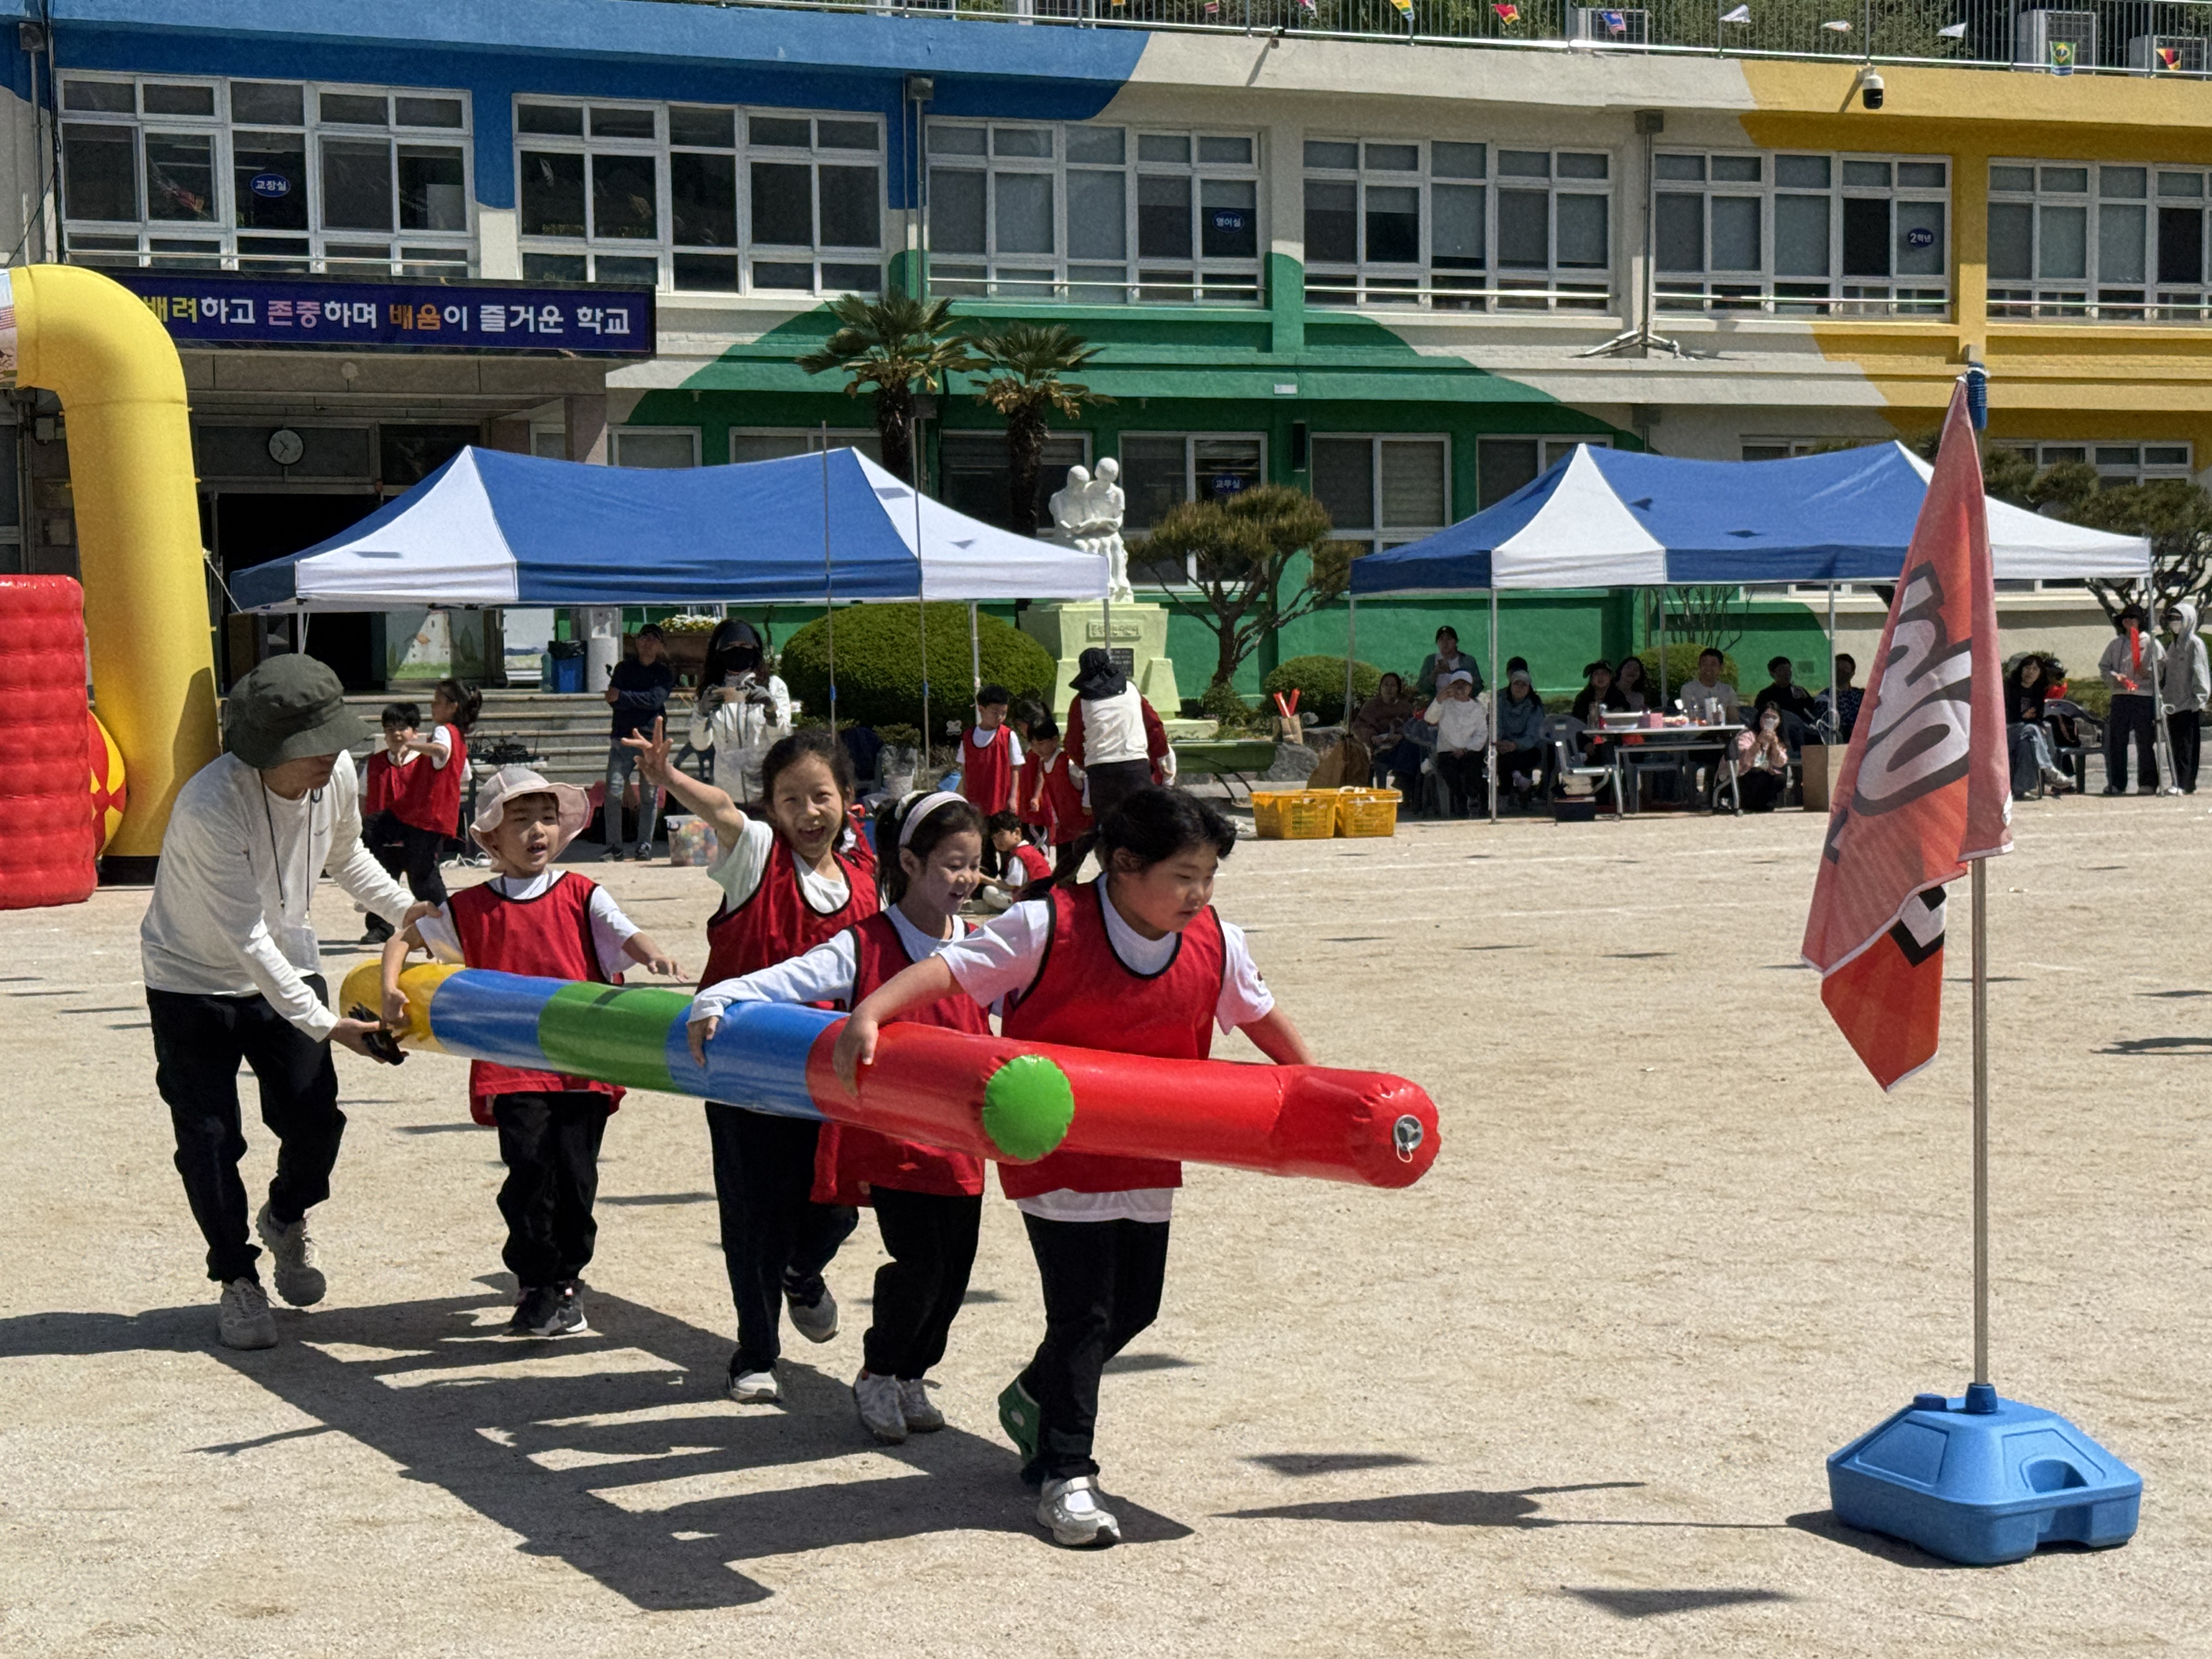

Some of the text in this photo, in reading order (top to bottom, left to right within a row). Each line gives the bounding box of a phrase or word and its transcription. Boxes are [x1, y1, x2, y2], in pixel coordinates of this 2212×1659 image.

[255, 180, 286, 191] 교장실
[143, 297, 630, 335] 배려하고 존중하며 배움이 즐거운 학교
[1216, 479, 1240, 489] 교무실
